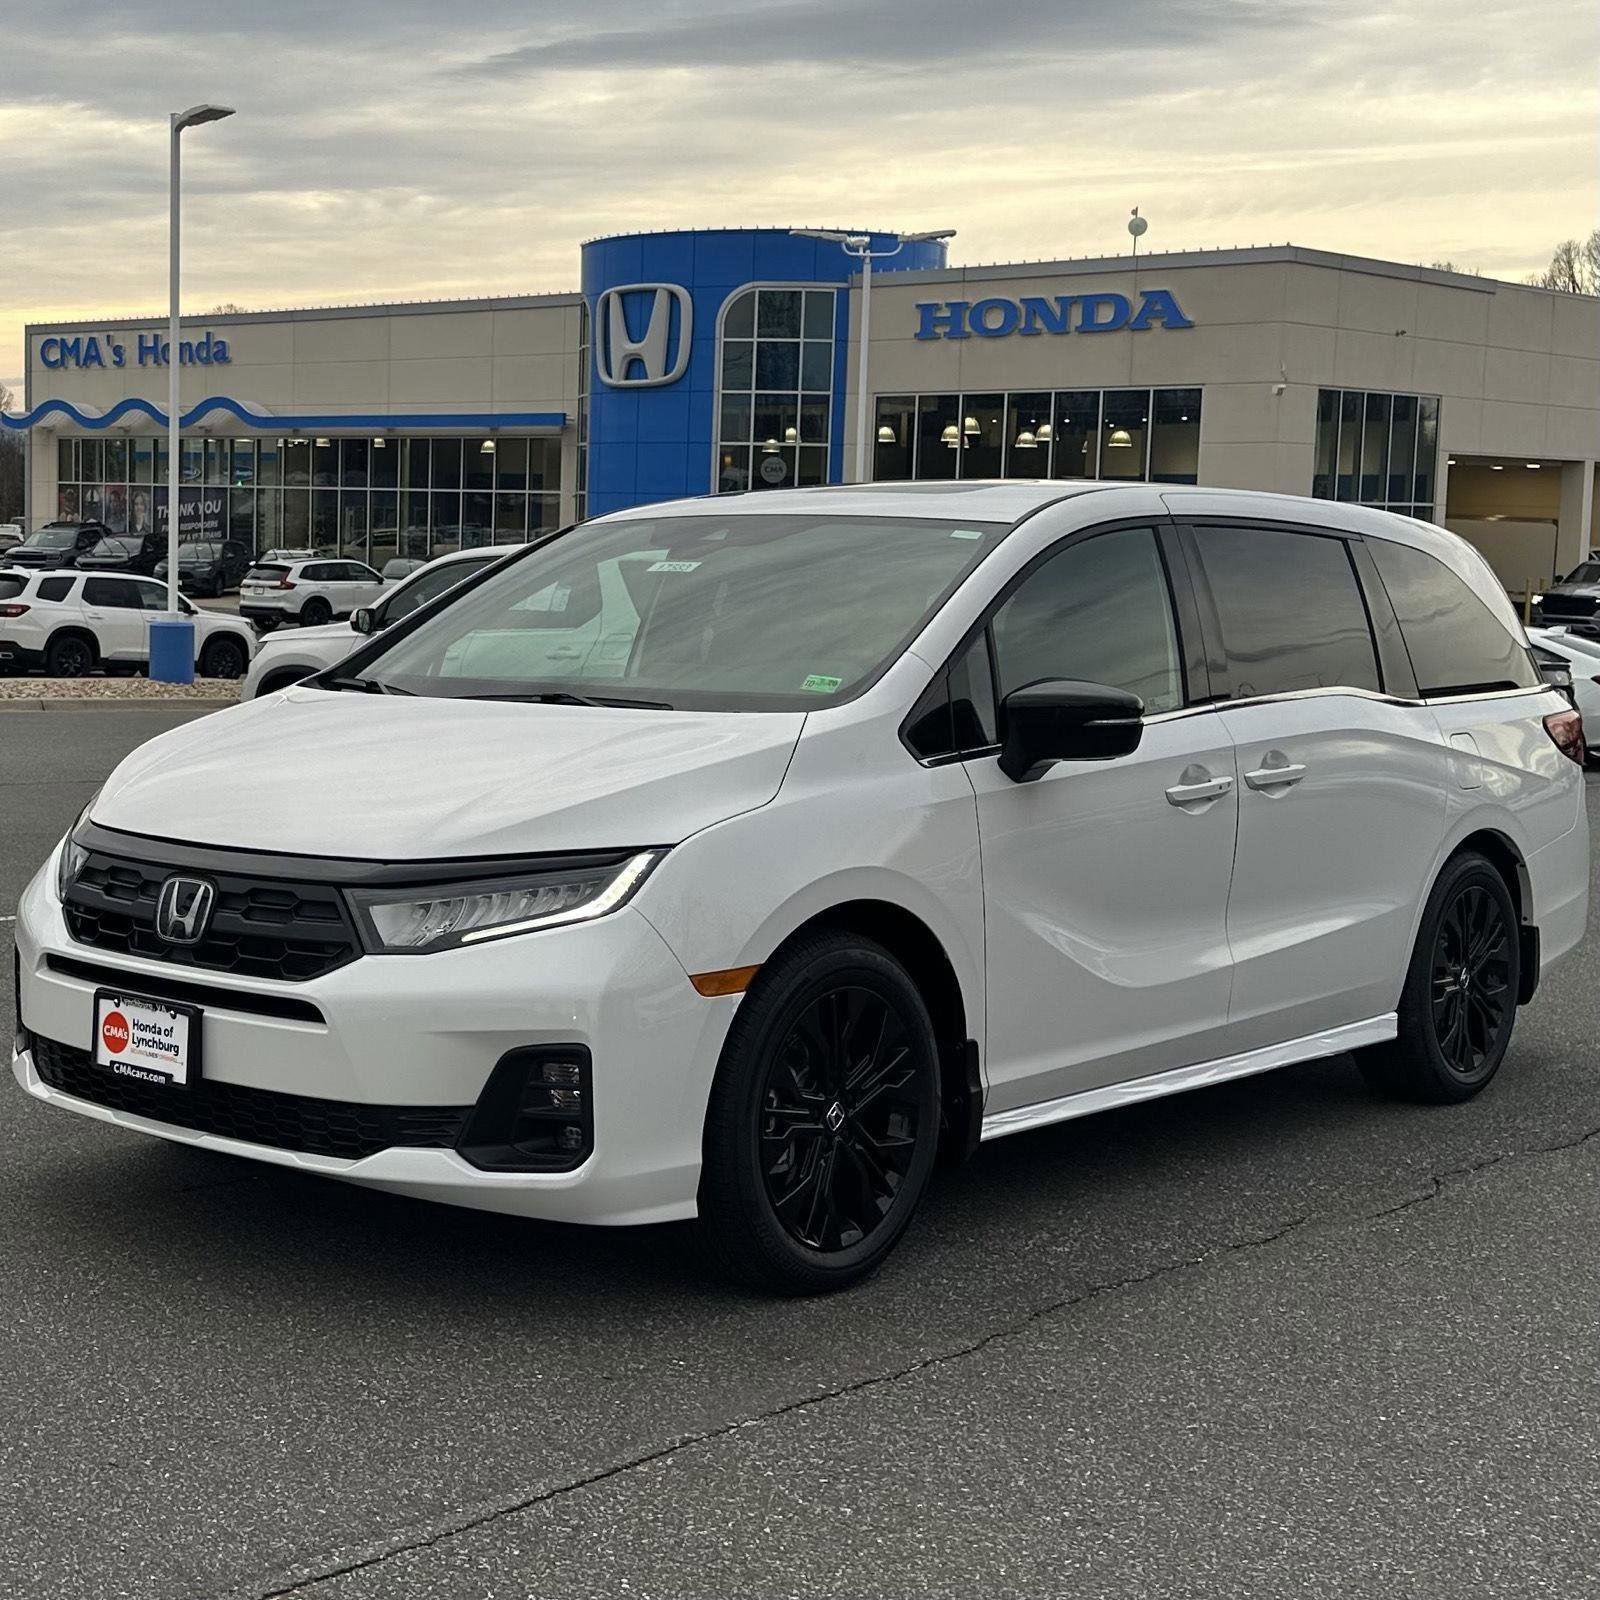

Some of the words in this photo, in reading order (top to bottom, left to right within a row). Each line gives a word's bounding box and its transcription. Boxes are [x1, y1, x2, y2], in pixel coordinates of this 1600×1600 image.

[914, 289, 1195, 340] HONDA
[40, 334, 125, 368] CMA's
[138, 331, 231, 366] Honda
[157, 502, 196, 519] THNK
[197, 500, 222, 515] YOU
[103, 1024, 128, 1040] CMA's
[132, 1018, 162, 1036] Honda
[163, 1026, 174, 1038] of
[131, 1033, 179, 1056] Lynchburg
[113, 1063, 166, 1084] CMAcars.com
